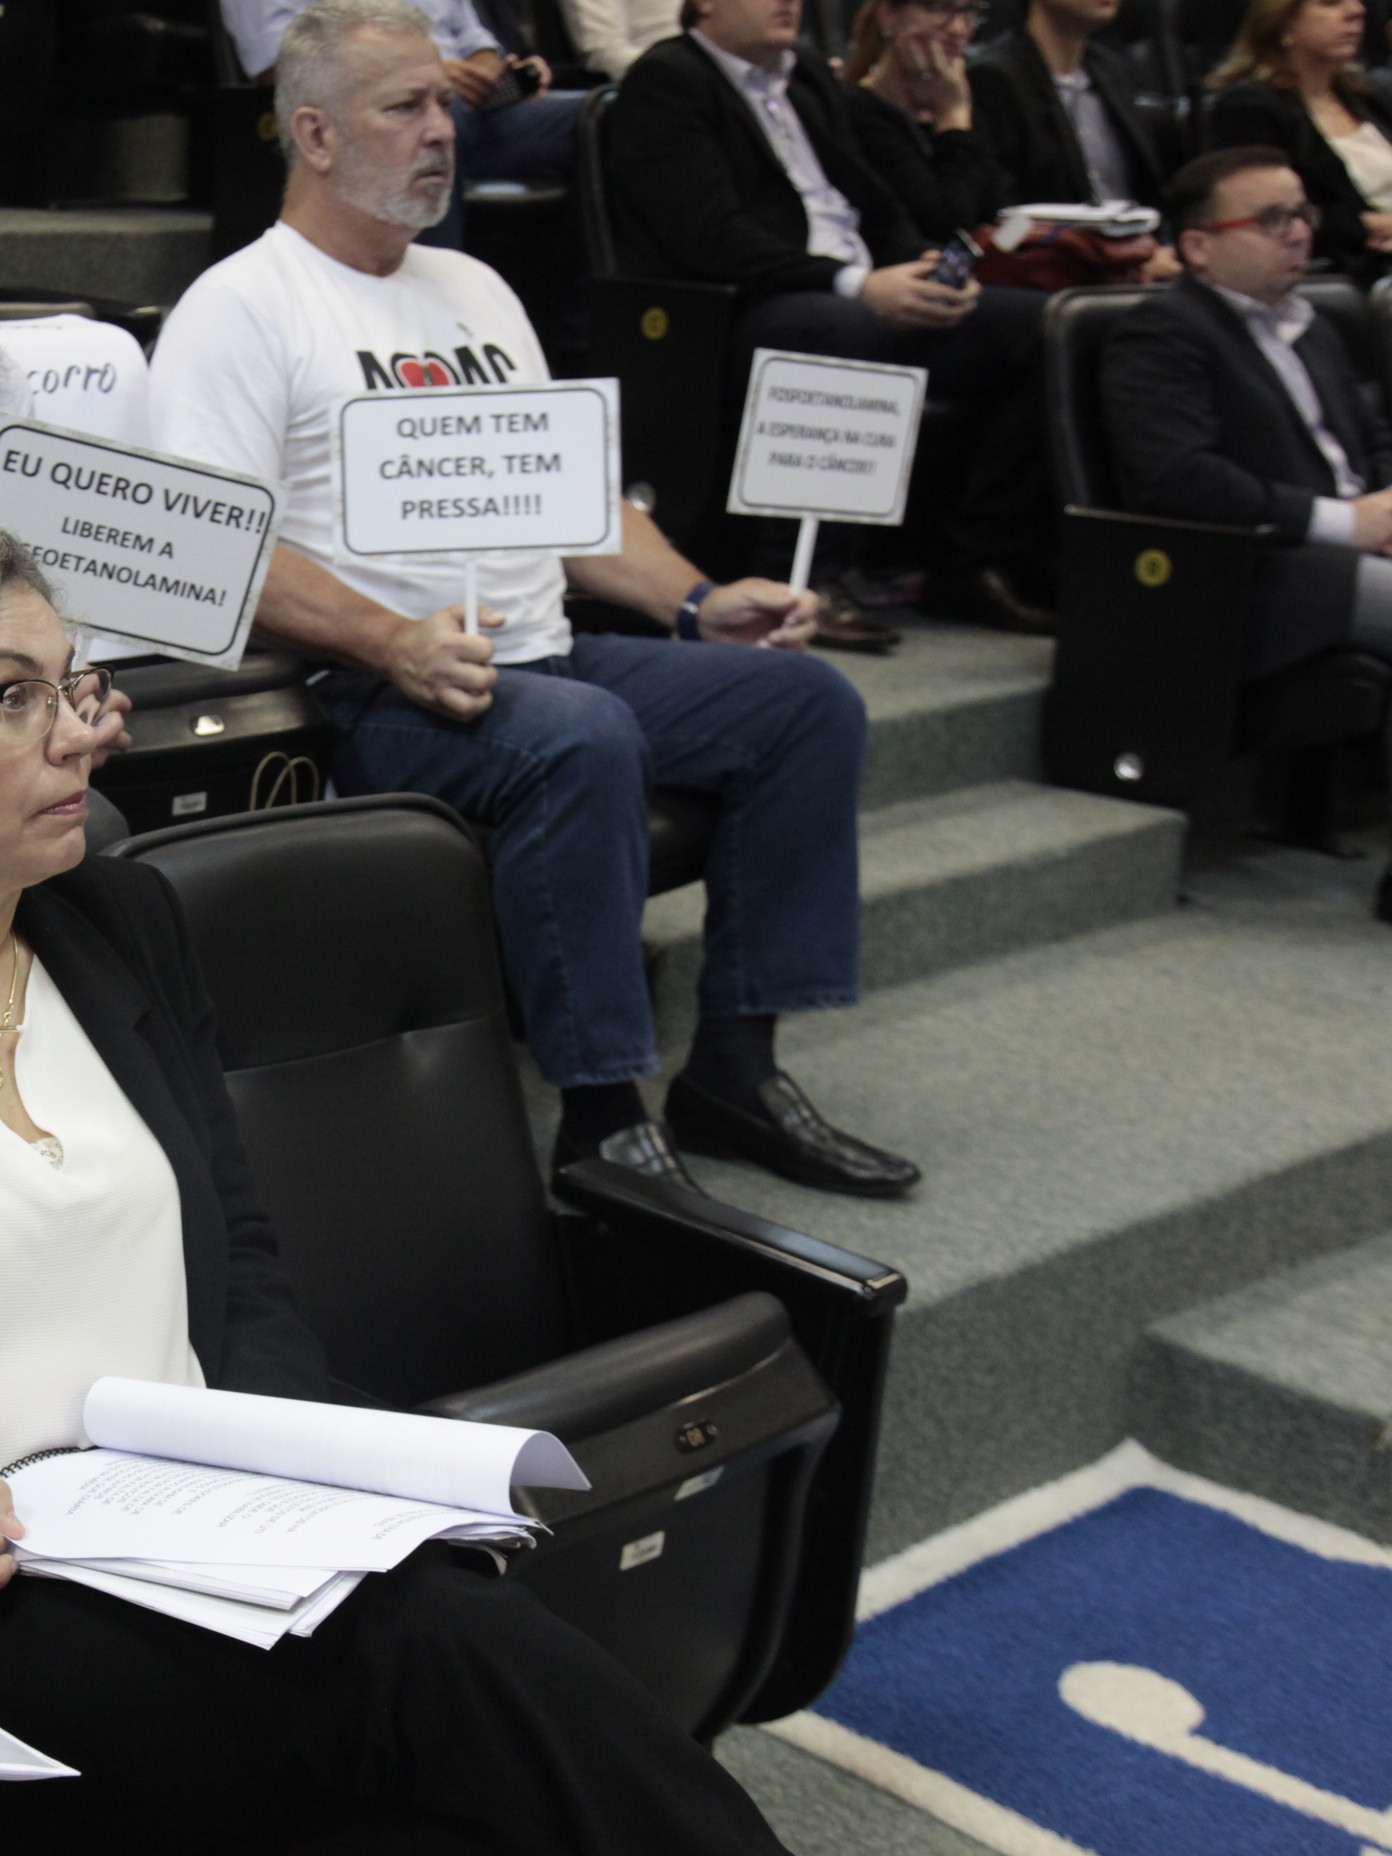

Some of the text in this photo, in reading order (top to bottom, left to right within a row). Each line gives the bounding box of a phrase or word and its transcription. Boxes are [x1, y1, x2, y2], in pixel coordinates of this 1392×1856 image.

[397, 413, 549, 439] QUEM TEM
[379, 454, 562, 479] CÂNCER, TEM
[2, 449, 267, 534] EU QUERO VIVER!!
[401, 495, 542, 519] PRESSA!!!!
[61, 517, 174, 559] LIBEREM A
[21, 543, 227, 607] FOETANOLAMINA!
